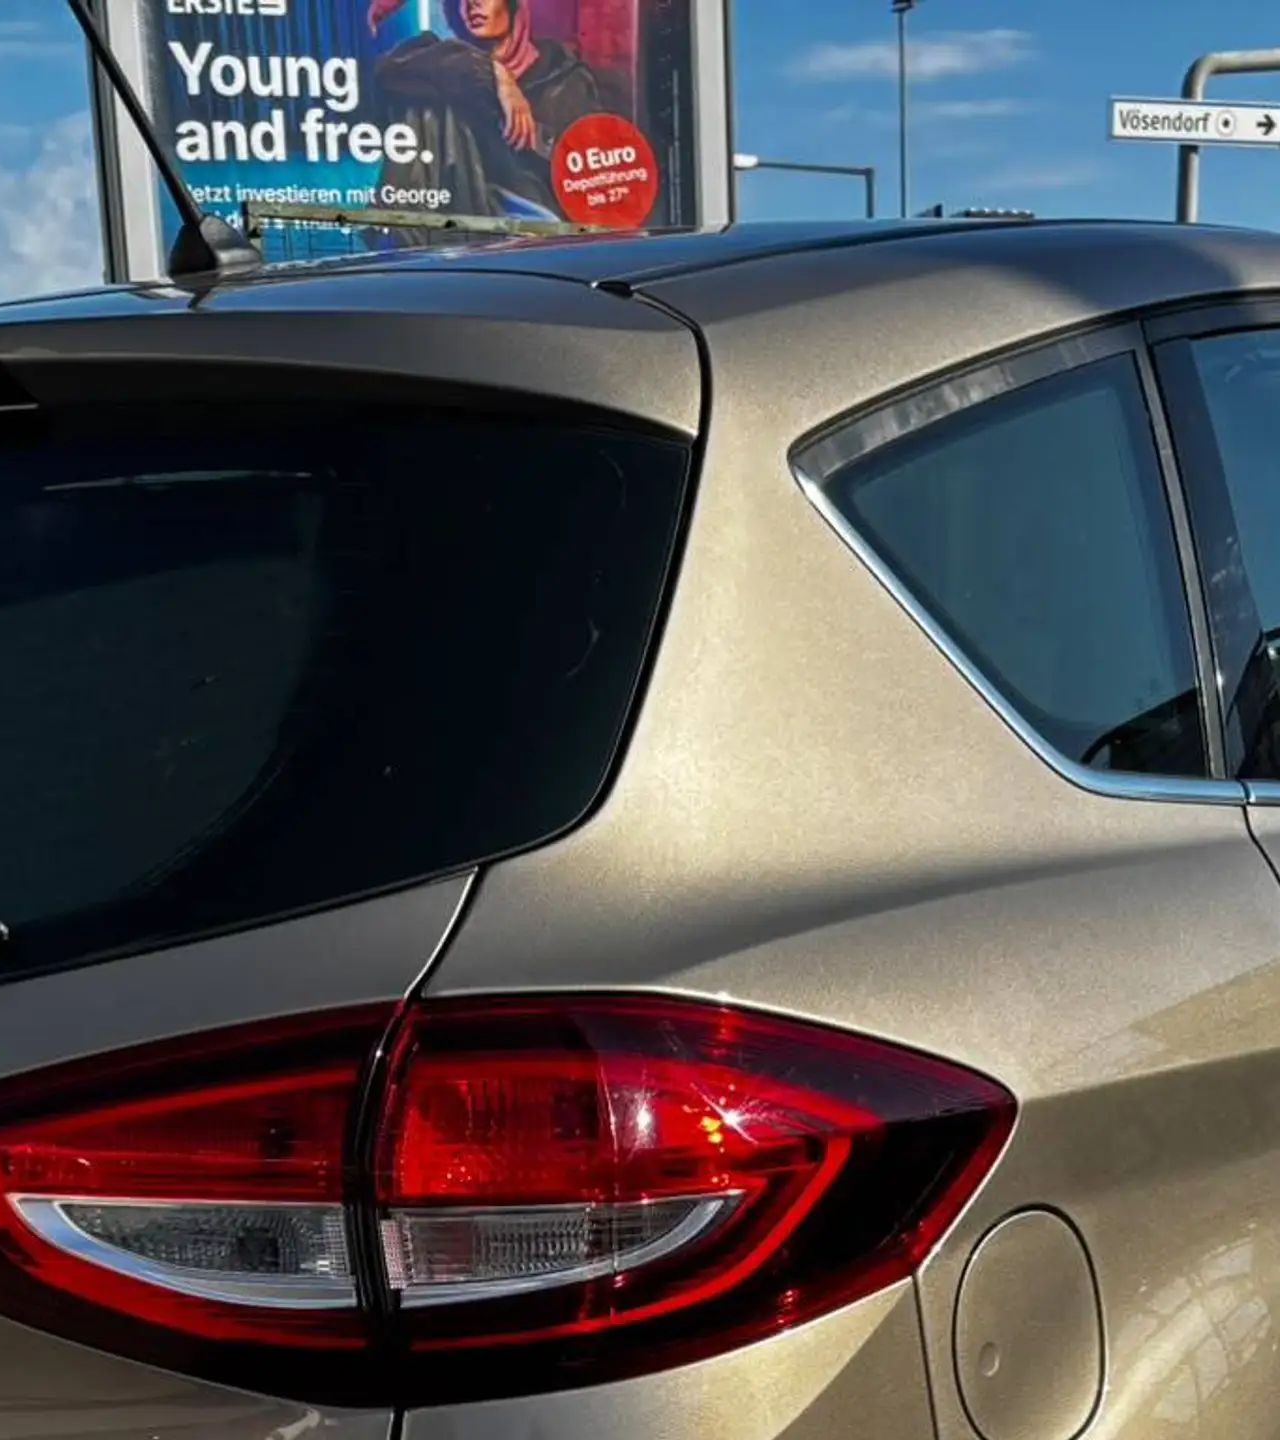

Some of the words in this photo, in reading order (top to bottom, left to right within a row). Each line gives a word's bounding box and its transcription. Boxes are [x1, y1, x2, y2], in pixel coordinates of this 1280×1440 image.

[168, 41, 360, 112] Young
[1120, 109, 1210, 132] Vösendorf
[175, 109, 286, 162] and
[301, 107, 434, 164] free.
[566, 151, 583, 173] 0
[585, 145, 636, 170] Euro
[235, 180, 342, 205] investieren
[346, 184, 375, 205] mit
[381, 185, 452, 208] George
